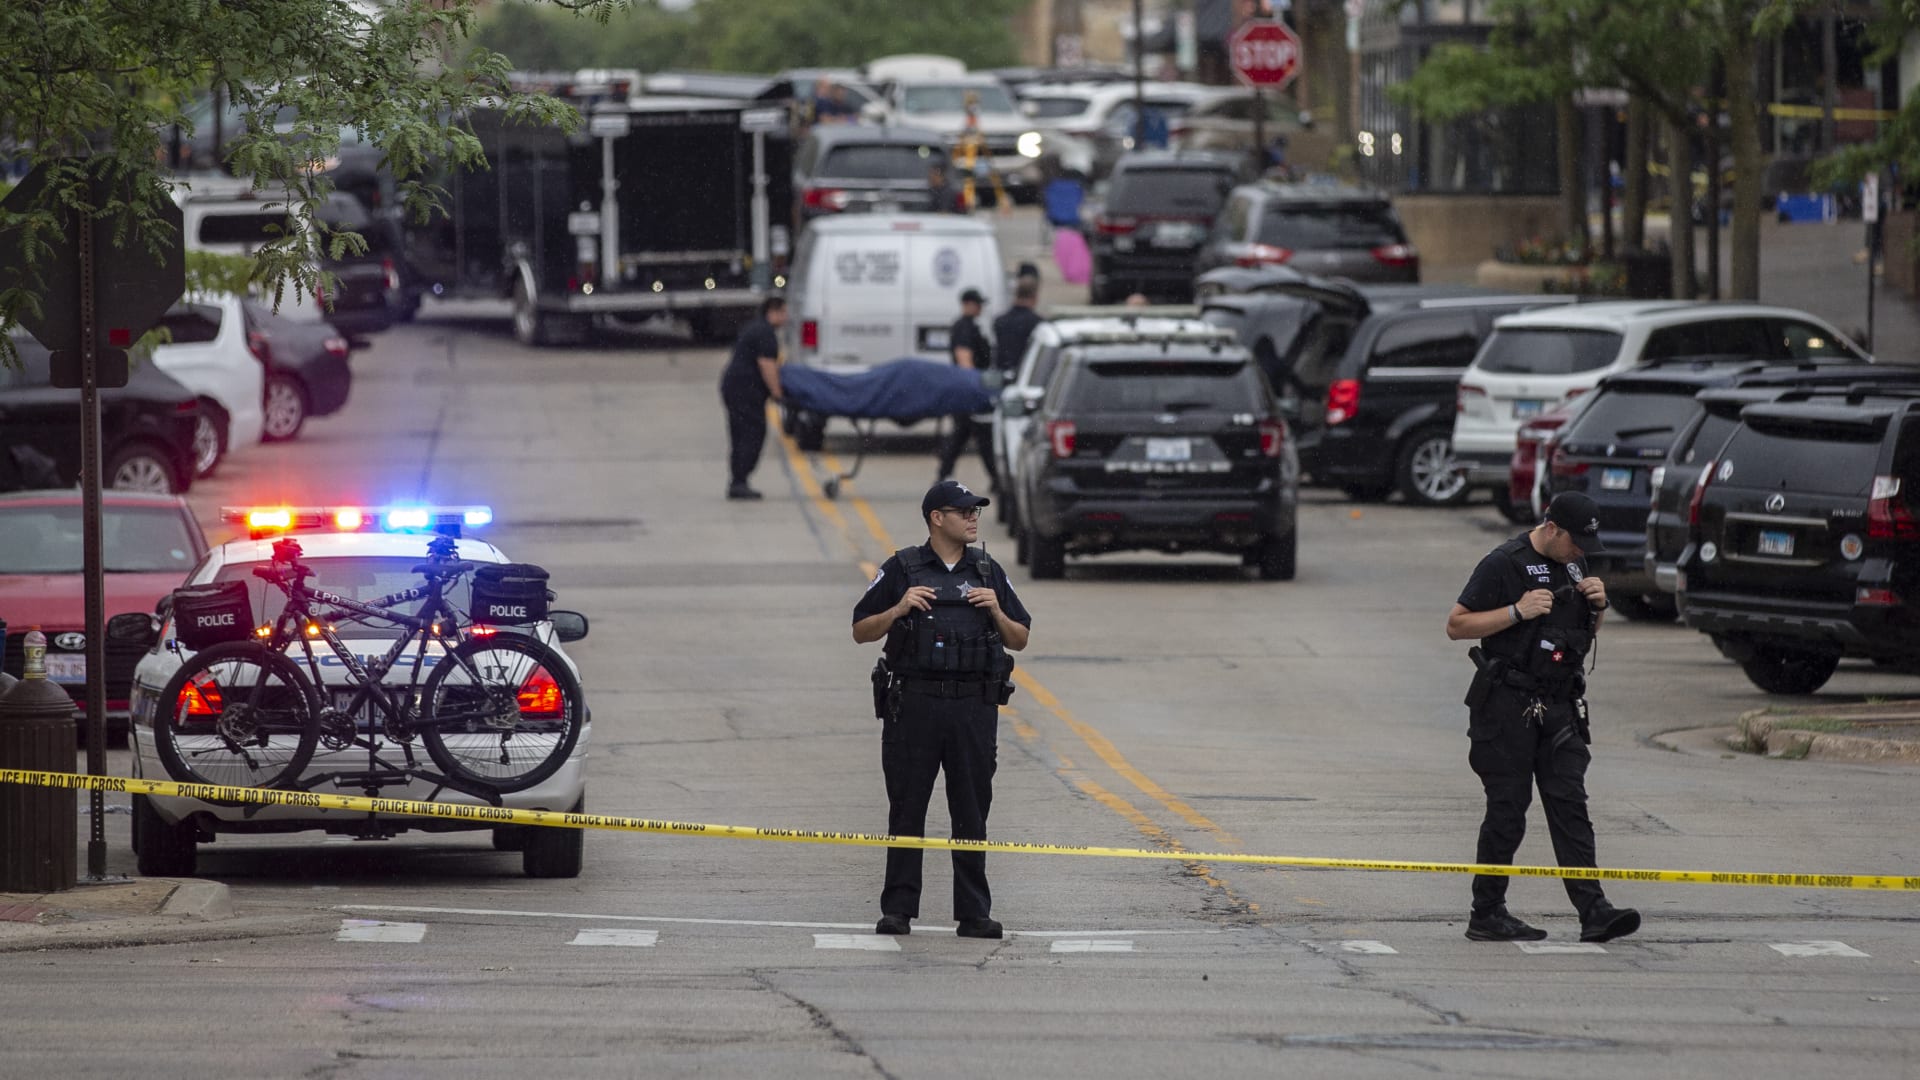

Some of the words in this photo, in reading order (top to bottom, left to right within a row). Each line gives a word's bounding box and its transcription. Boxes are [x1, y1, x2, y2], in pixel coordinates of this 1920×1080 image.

[1238, 41, 1296, 69] STOP
[1526, 564, 1551, 576] POLICE
[313, 590, 340, 604] LPD
[489, 604, 527, 617] POLICE
[197, 613, 235, 627] POLICE
[33, 647, 42, 658] G
[484, 665, 509, 680] 17
[1, 771, 21, 784] ICE
[23, 772, 46, 786] LINE
[49, 774, 64, 788] DO
[67, 775, 88, 790] NOT
[91, 777, 126, 792] CROSS
[177, 784, 215, 801] POLICE
[218, 787, 241, 802] LINE
[244, 789, 259, 803] DO
[262, 791, 284, 805] NOT
[286, 792, 321, 807] CROSS
[371, 800, 409, 814] POLICE
[412, 803, 434, 816] LINE
[438, 805, 452, 817] DO
[455, 806, 476, 819] NOT
[479, 808, 514, 820] CROSS
[564, 814, 602, 826] POLICE
[604, 817, 628, 828] LINE
